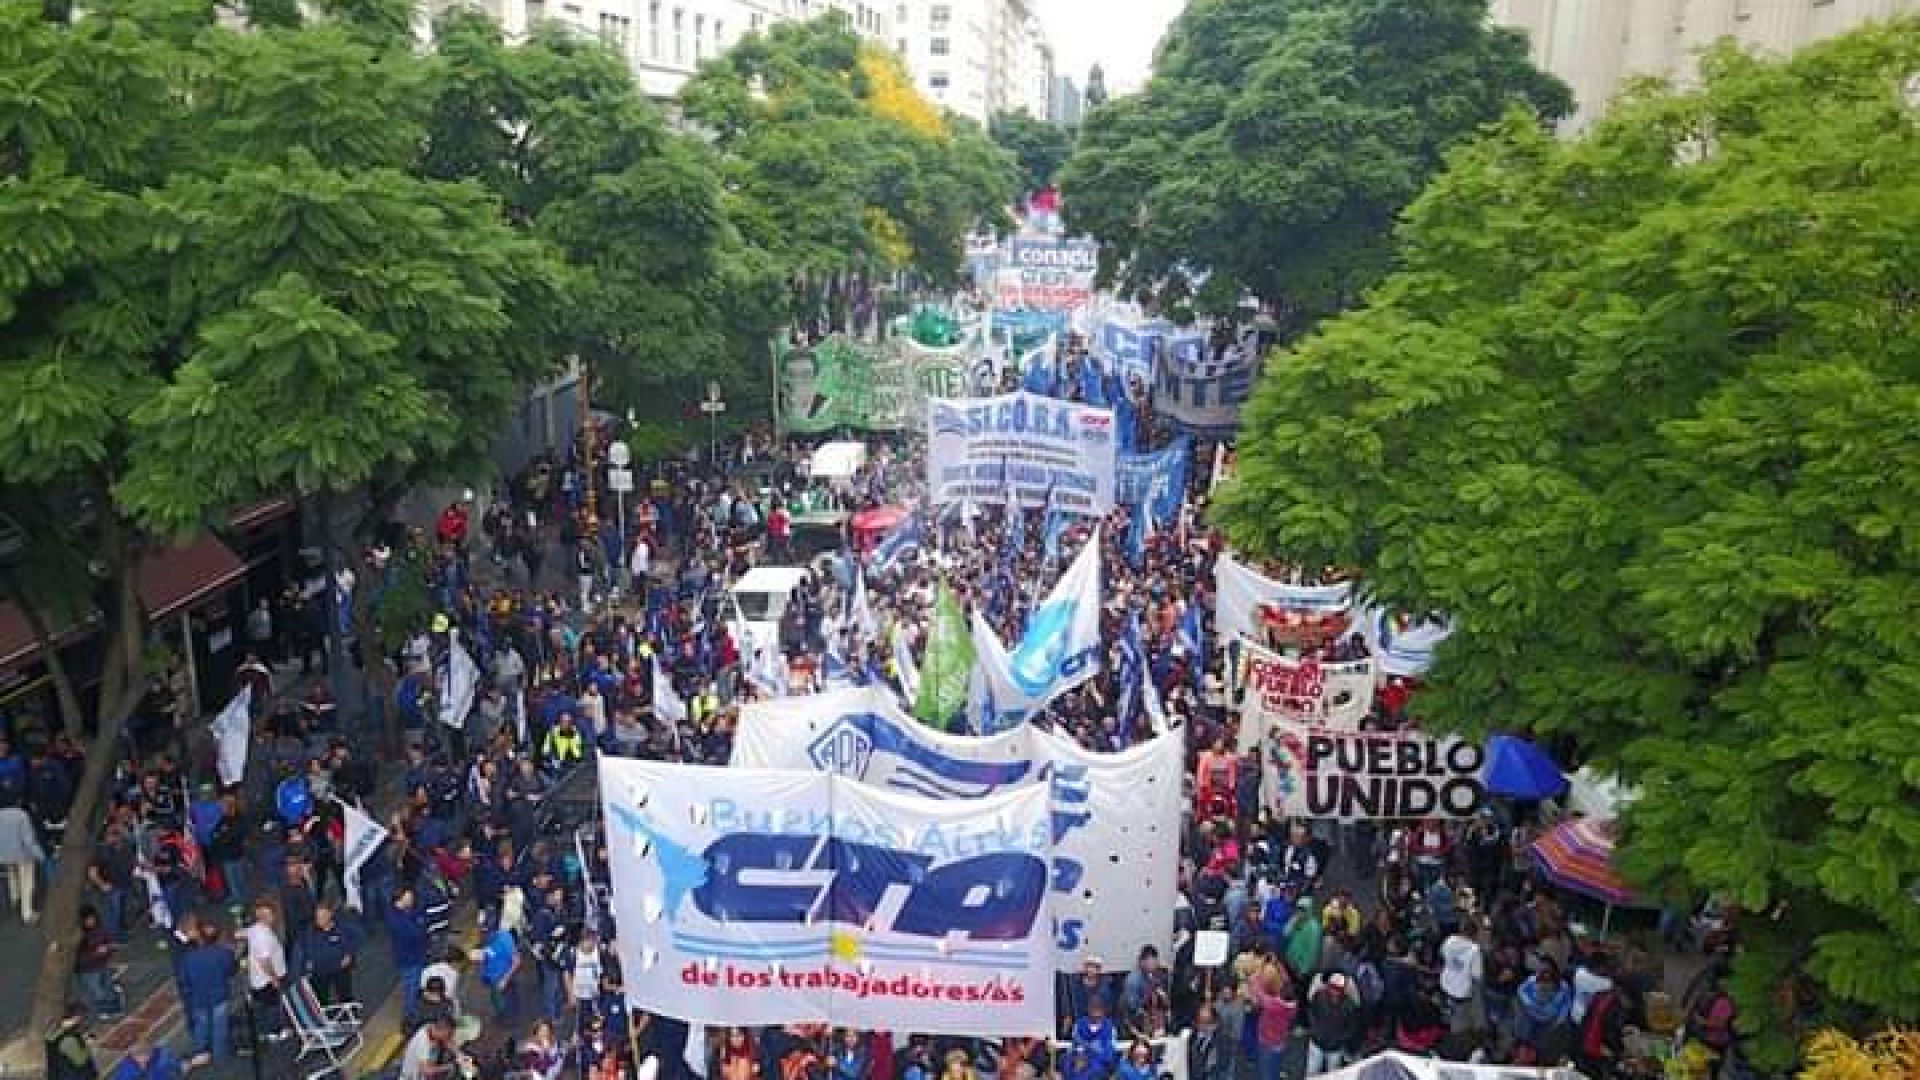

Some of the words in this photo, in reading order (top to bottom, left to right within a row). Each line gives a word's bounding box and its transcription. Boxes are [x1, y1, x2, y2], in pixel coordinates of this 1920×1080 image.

[1306, 736, 1485, 776] PUEBLO
[1306, 774, 1486, 817] UNIDO
[691, 831, 1049, 940] CTA
[681, 961, 719, 986] de
[725, 963, 773, 989] los
